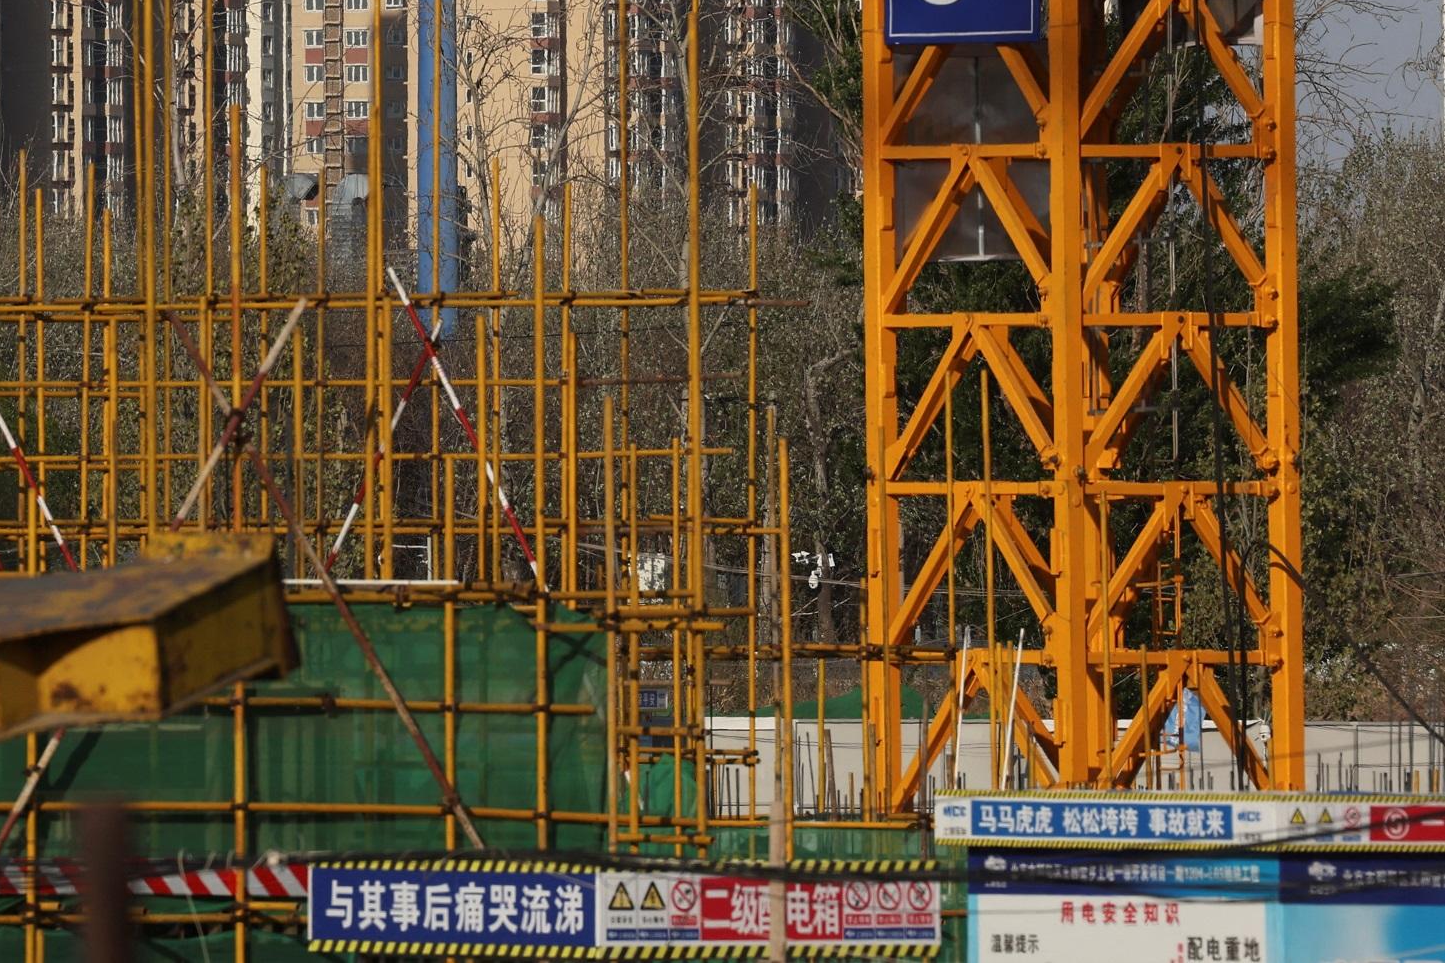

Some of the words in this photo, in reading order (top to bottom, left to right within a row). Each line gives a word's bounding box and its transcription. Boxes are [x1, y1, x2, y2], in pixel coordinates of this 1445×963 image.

[978, 805, 1054, 834] 马马虎虎
[1062, 806, 1138, 835] 松松垮垮
[1148, 807, 1225, 837] 事故就来
[325, 880, 585, 935] 与其事后痛哭流涕
[1060, 901, 1180, 925] 用电安全知识
[1187, 937, 1261, 962] 配电重地
